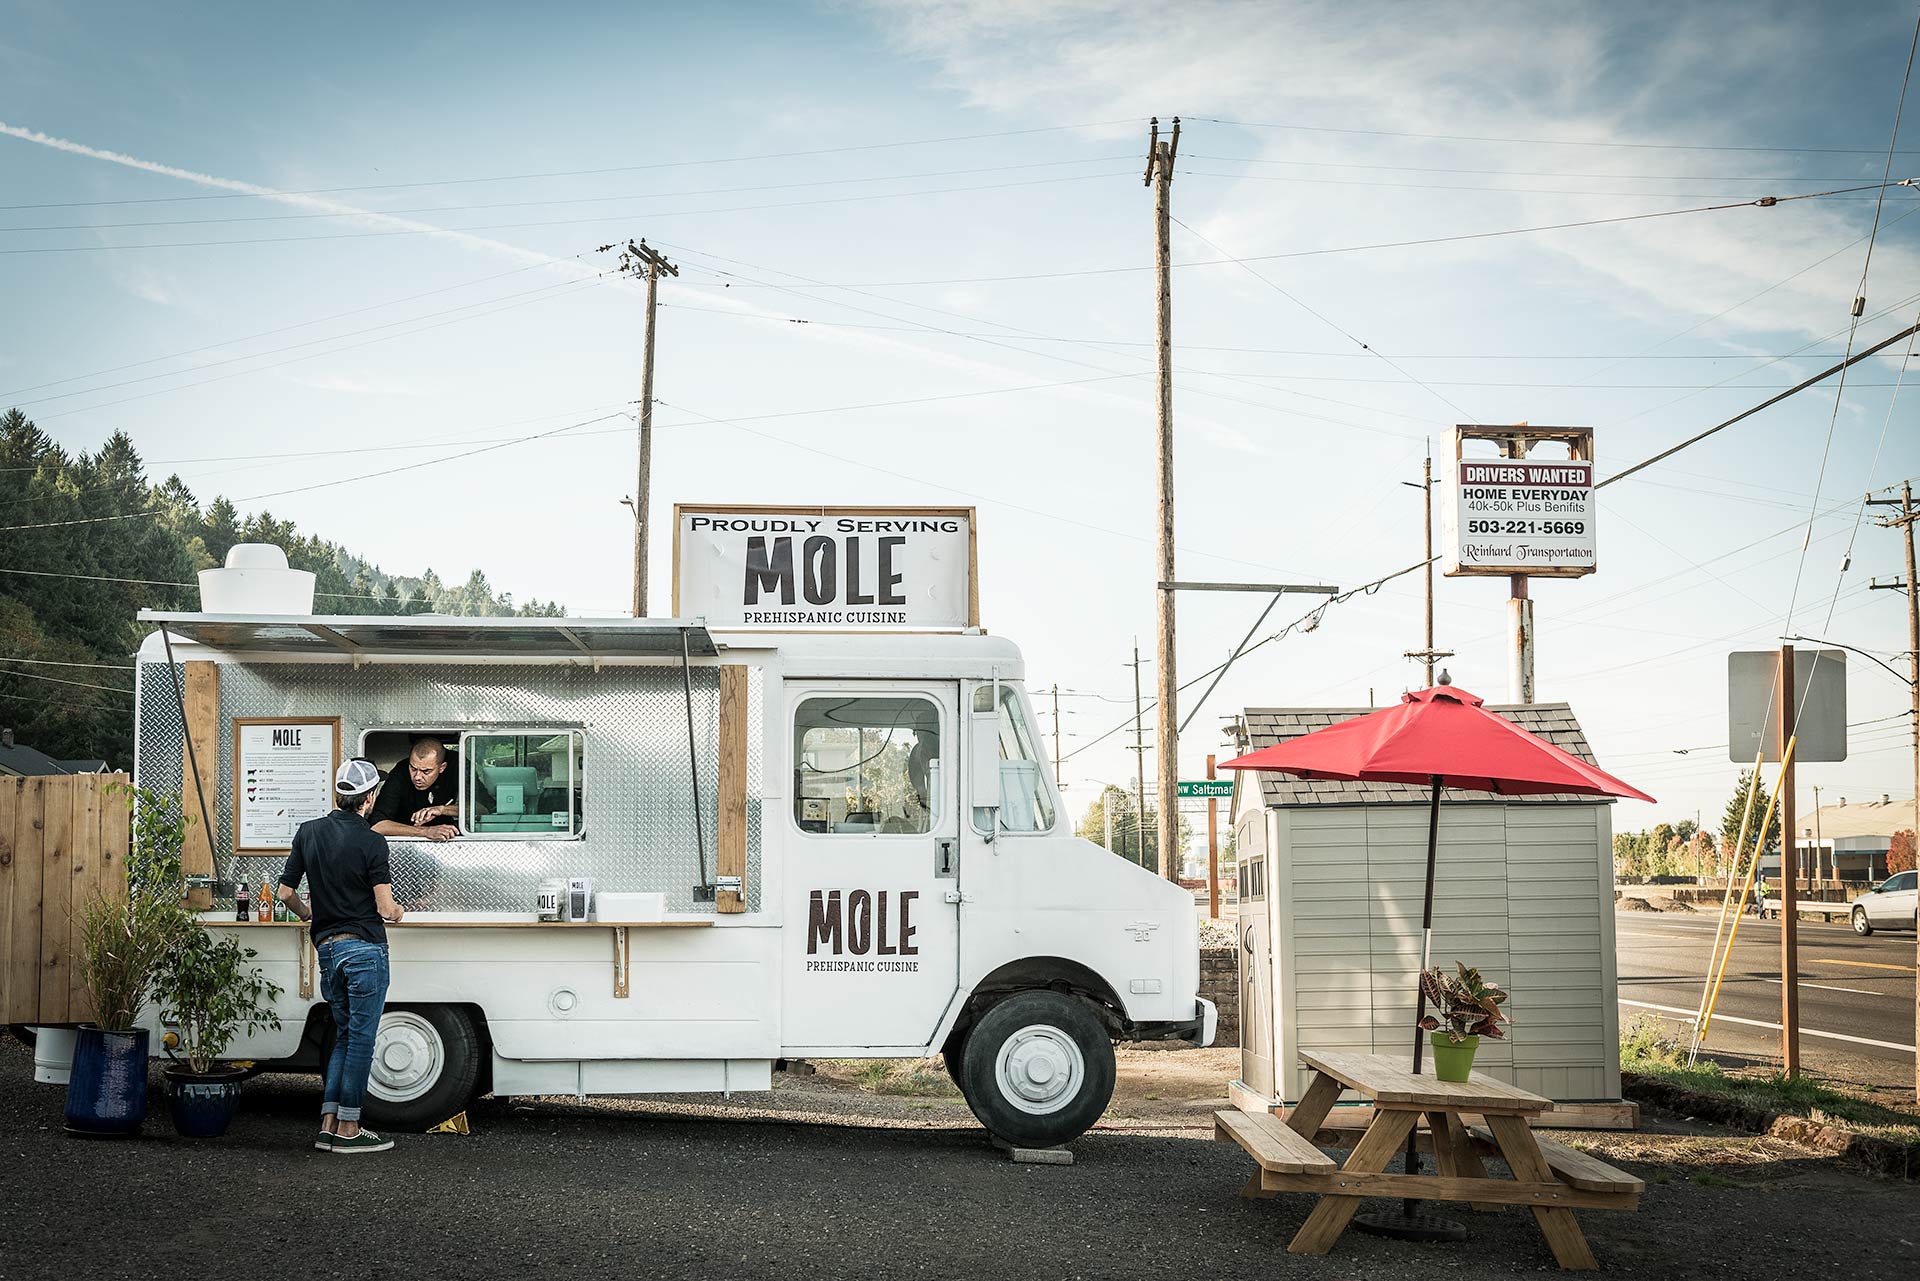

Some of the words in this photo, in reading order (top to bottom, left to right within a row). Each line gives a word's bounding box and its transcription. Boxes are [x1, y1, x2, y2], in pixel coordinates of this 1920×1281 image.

[1467, 468, 1525, 483] DRIVERS
[1529, 469, 1586, 484] WANTED
[1464, 489, 1507, 500] HOME
[1512, 490, 1589, 501] EVERYDAY
[1468, 501, 1514, 512] 40k-50k
[1517, 501, 1541, 512] Plus
[1545, 502, 1585, 512] Benifits
[1469, 521, 1585, 535] 503-221-5669
[1462, 544, 1512, 561] Reinhard
[1516, 545, 1593, 561] Transportation
[744, 536, 906, 606] MOLE
[744, 612, 842, 624] PREHISPANIC
[847, 612, 907, 624] CUISINE
[272, 729, 302, 747] MOLE
[1178, 786, 1189, 794] NW
[807, 890, 920, 956] MOLE
[807, 961, 875, 972] PREHISPANIC
[878, 961, 919, 973] CUISINE
